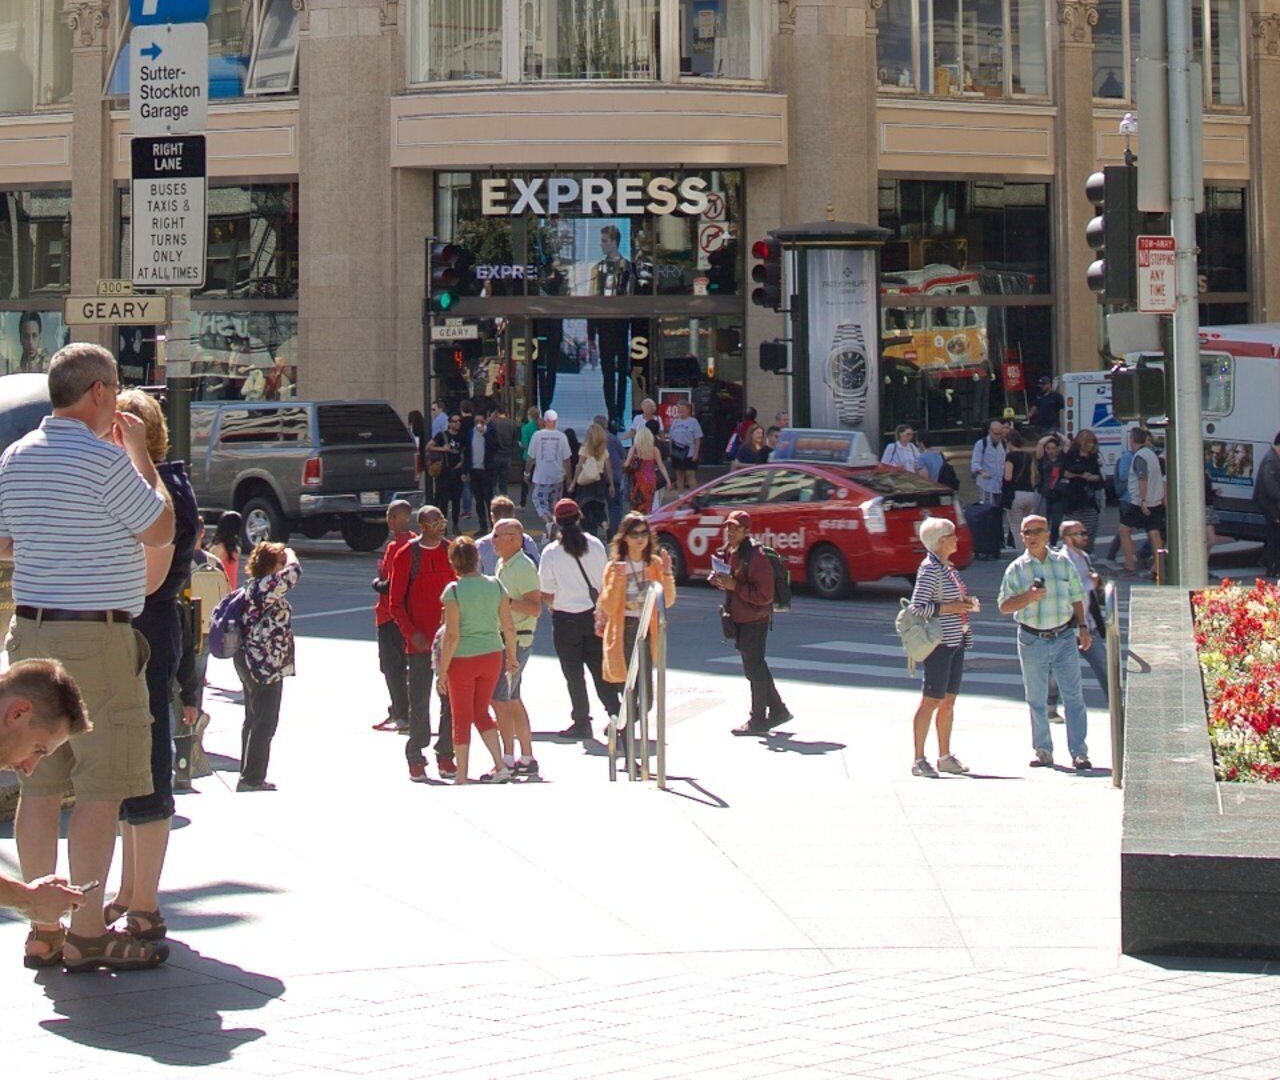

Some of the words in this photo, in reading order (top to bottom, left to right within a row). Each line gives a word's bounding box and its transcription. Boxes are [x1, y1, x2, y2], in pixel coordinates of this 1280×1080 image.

[140, 65, 186, 81] Sutter-
[140, 84, 201, 100] Stockton
[140, 103, 189, 121] Garage
[152, 142, 184, 156] RIGHT
[153, 157, 182, 171] LANE
[150, 183, 188, 196] BUSES
[481, 177, 708, 215] EXPRESS
[147, 200, 178, 212] TAXIS
[183, 199, 190, 212] &
[152, 217, 185, 229] RIGHT
[150, 233, 188, 246] TURNS
[1141, 239, 1173, 249] TOW-AWAY
[153, 250, 183, 262] ONLY
[138, 267, 149, 279] AT
[151, 267, 169, 280] ALL
[172, 266, 199, 279] TIMES
[1150, 270, 1165, 281] ANY
[102, 282, 121, 293] 300
[1149, 284, 1166, 297] TIME
[82, 302, 149, 319] GEARY
[440, 328, 469, 337] GEARY
